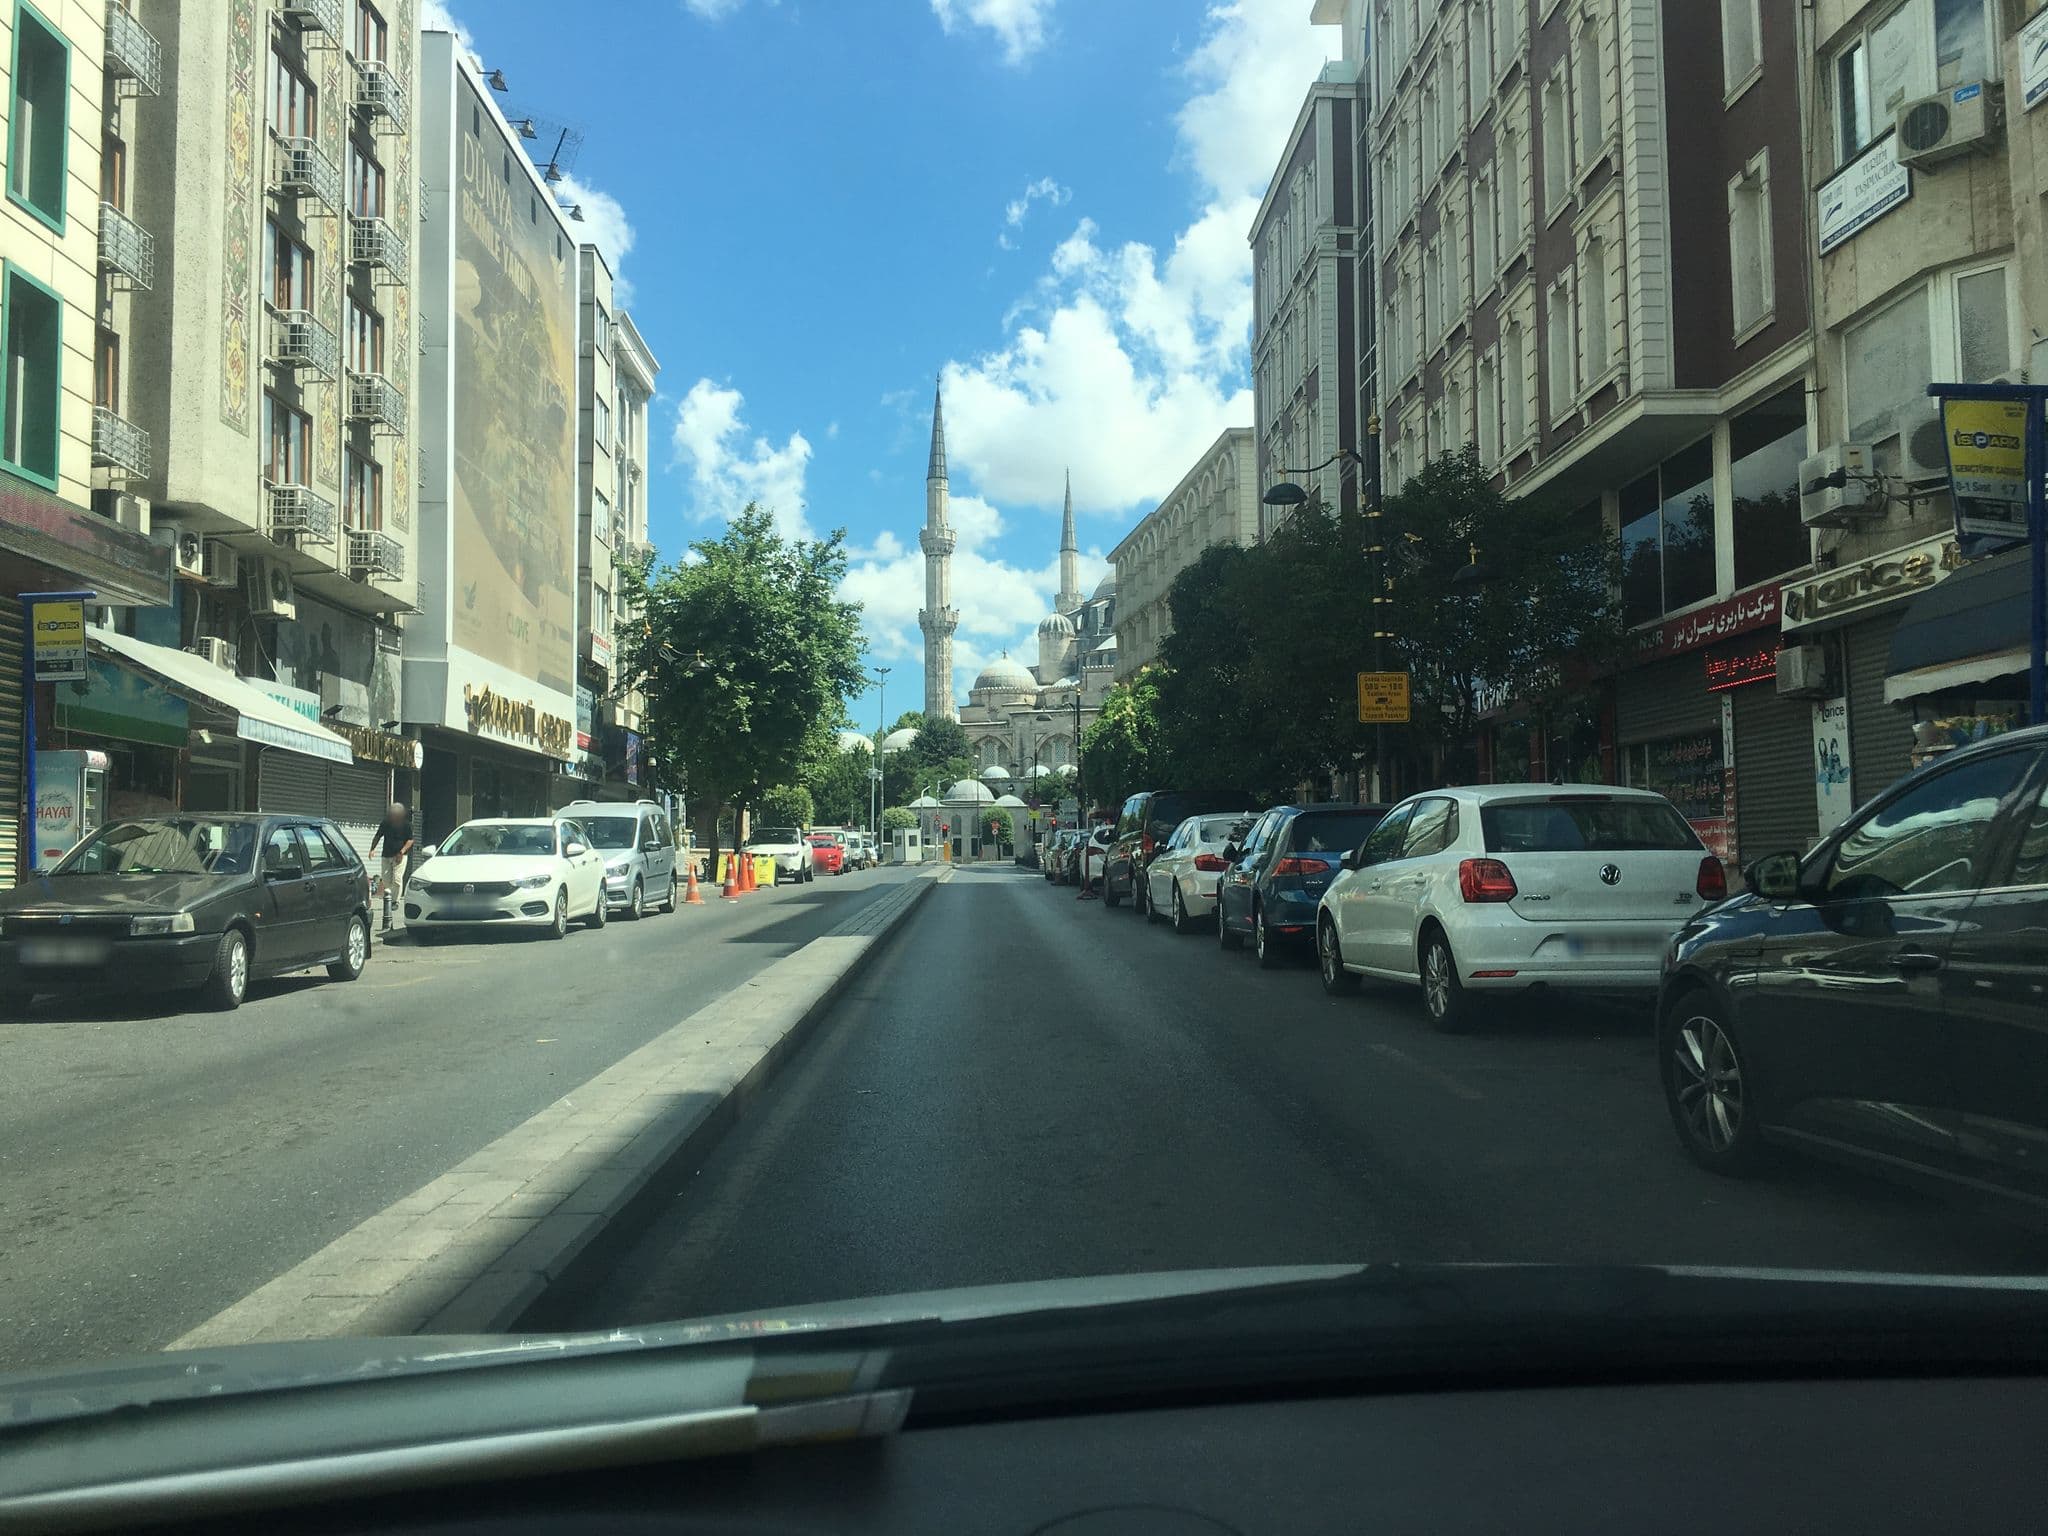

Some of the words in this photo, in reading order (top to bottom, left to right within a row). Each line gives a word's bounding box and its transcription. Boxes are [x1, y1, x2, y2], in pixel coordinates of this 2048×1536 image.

[464, 131, 513, 238] DÜNYA
[1717, 602, 1745, 634] باربری
[1746, 592, 1775, 622] شرکت
[36, 806, 73, 819] HAYAT
